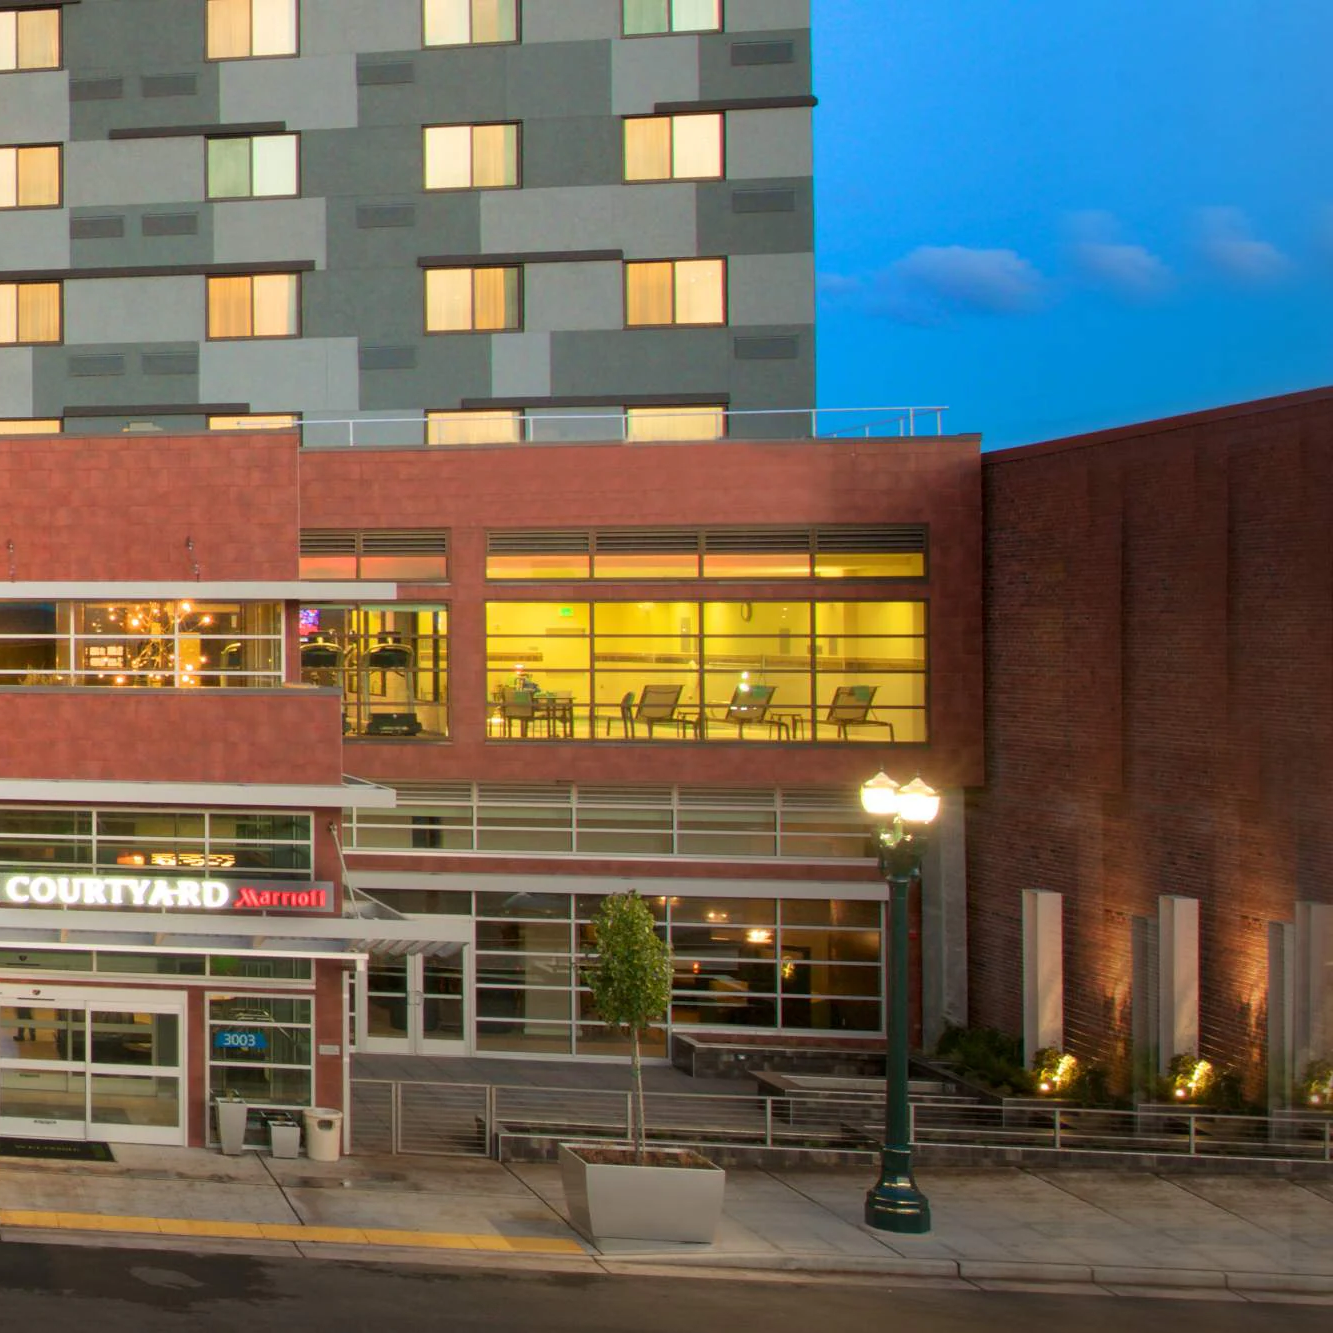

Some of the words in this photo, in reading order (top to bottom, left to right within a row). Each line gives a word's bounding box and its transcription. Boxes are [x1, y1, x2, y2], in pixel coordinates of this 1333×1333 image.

[6, 876, 230, 908] COURTYARD
[235, 887, 326, 908] Marriott
[223, 1033, 256, 1047] 3003
